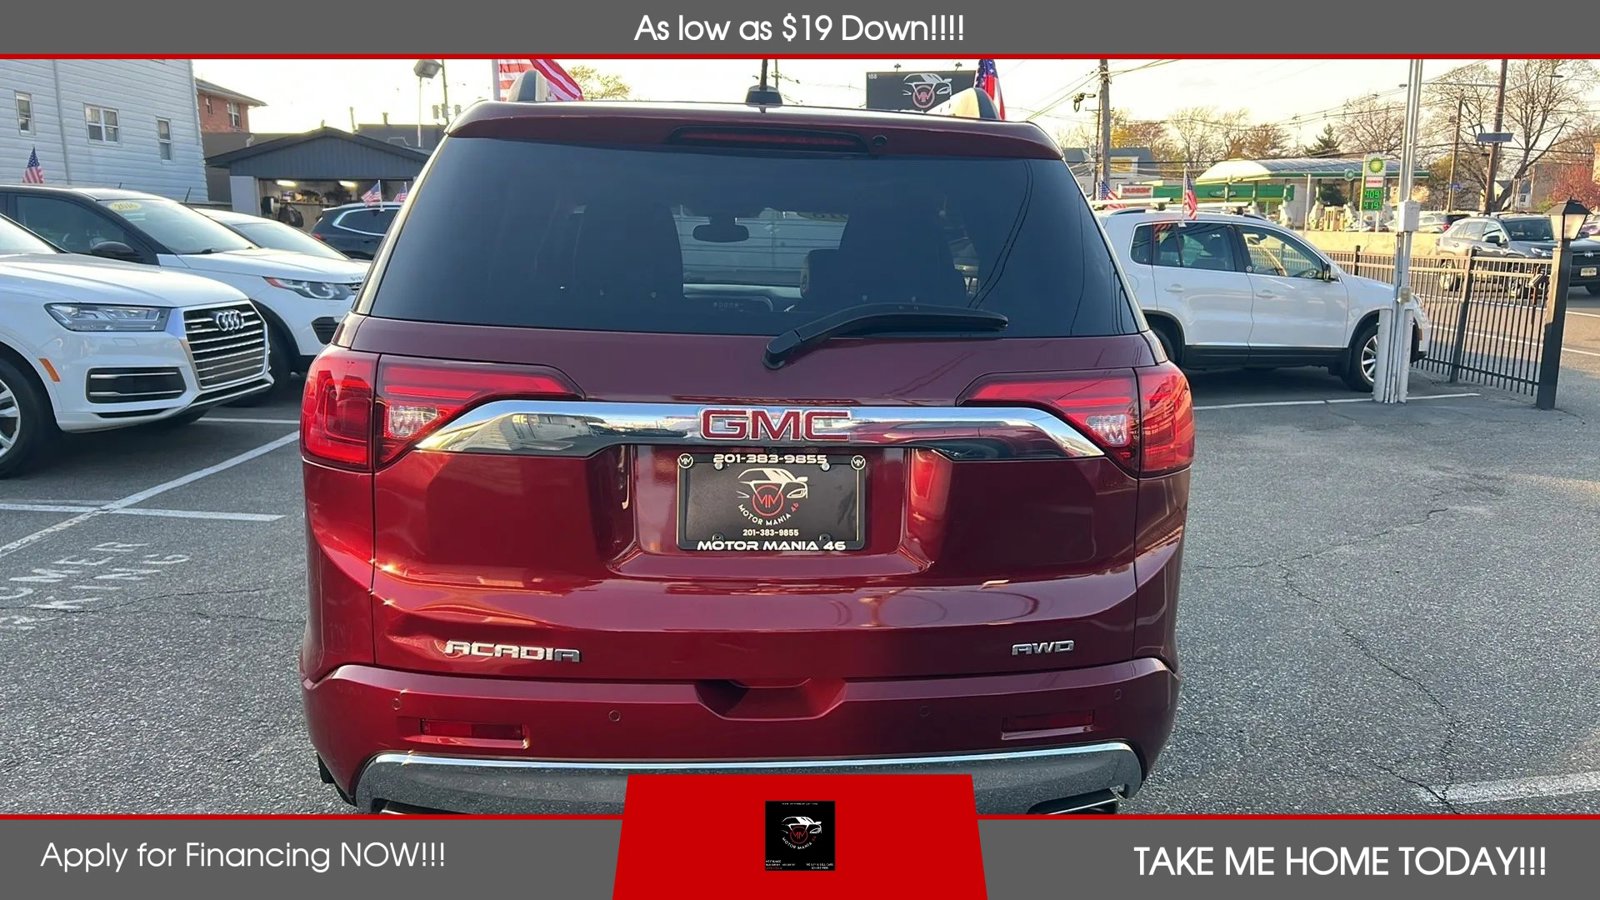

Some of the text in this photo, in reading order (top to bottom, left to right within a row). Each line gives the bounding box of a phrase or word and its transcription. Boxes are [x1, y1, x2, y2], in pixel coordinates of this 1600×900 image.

[700, 407, 850, 441] GMC
[713, 454, 828, 464] 201-383-9855
[738, 504, 763, 525] MOTOR
[765, 512, 792, 526] MANIA
[742, 528, 799, 537] 201-383-9855
[697, 540, 846, 551] MOTOR MANIA 46
[444, 639, 581, 663] ACADIA
[1011, 639, 1075, 656] AWD
